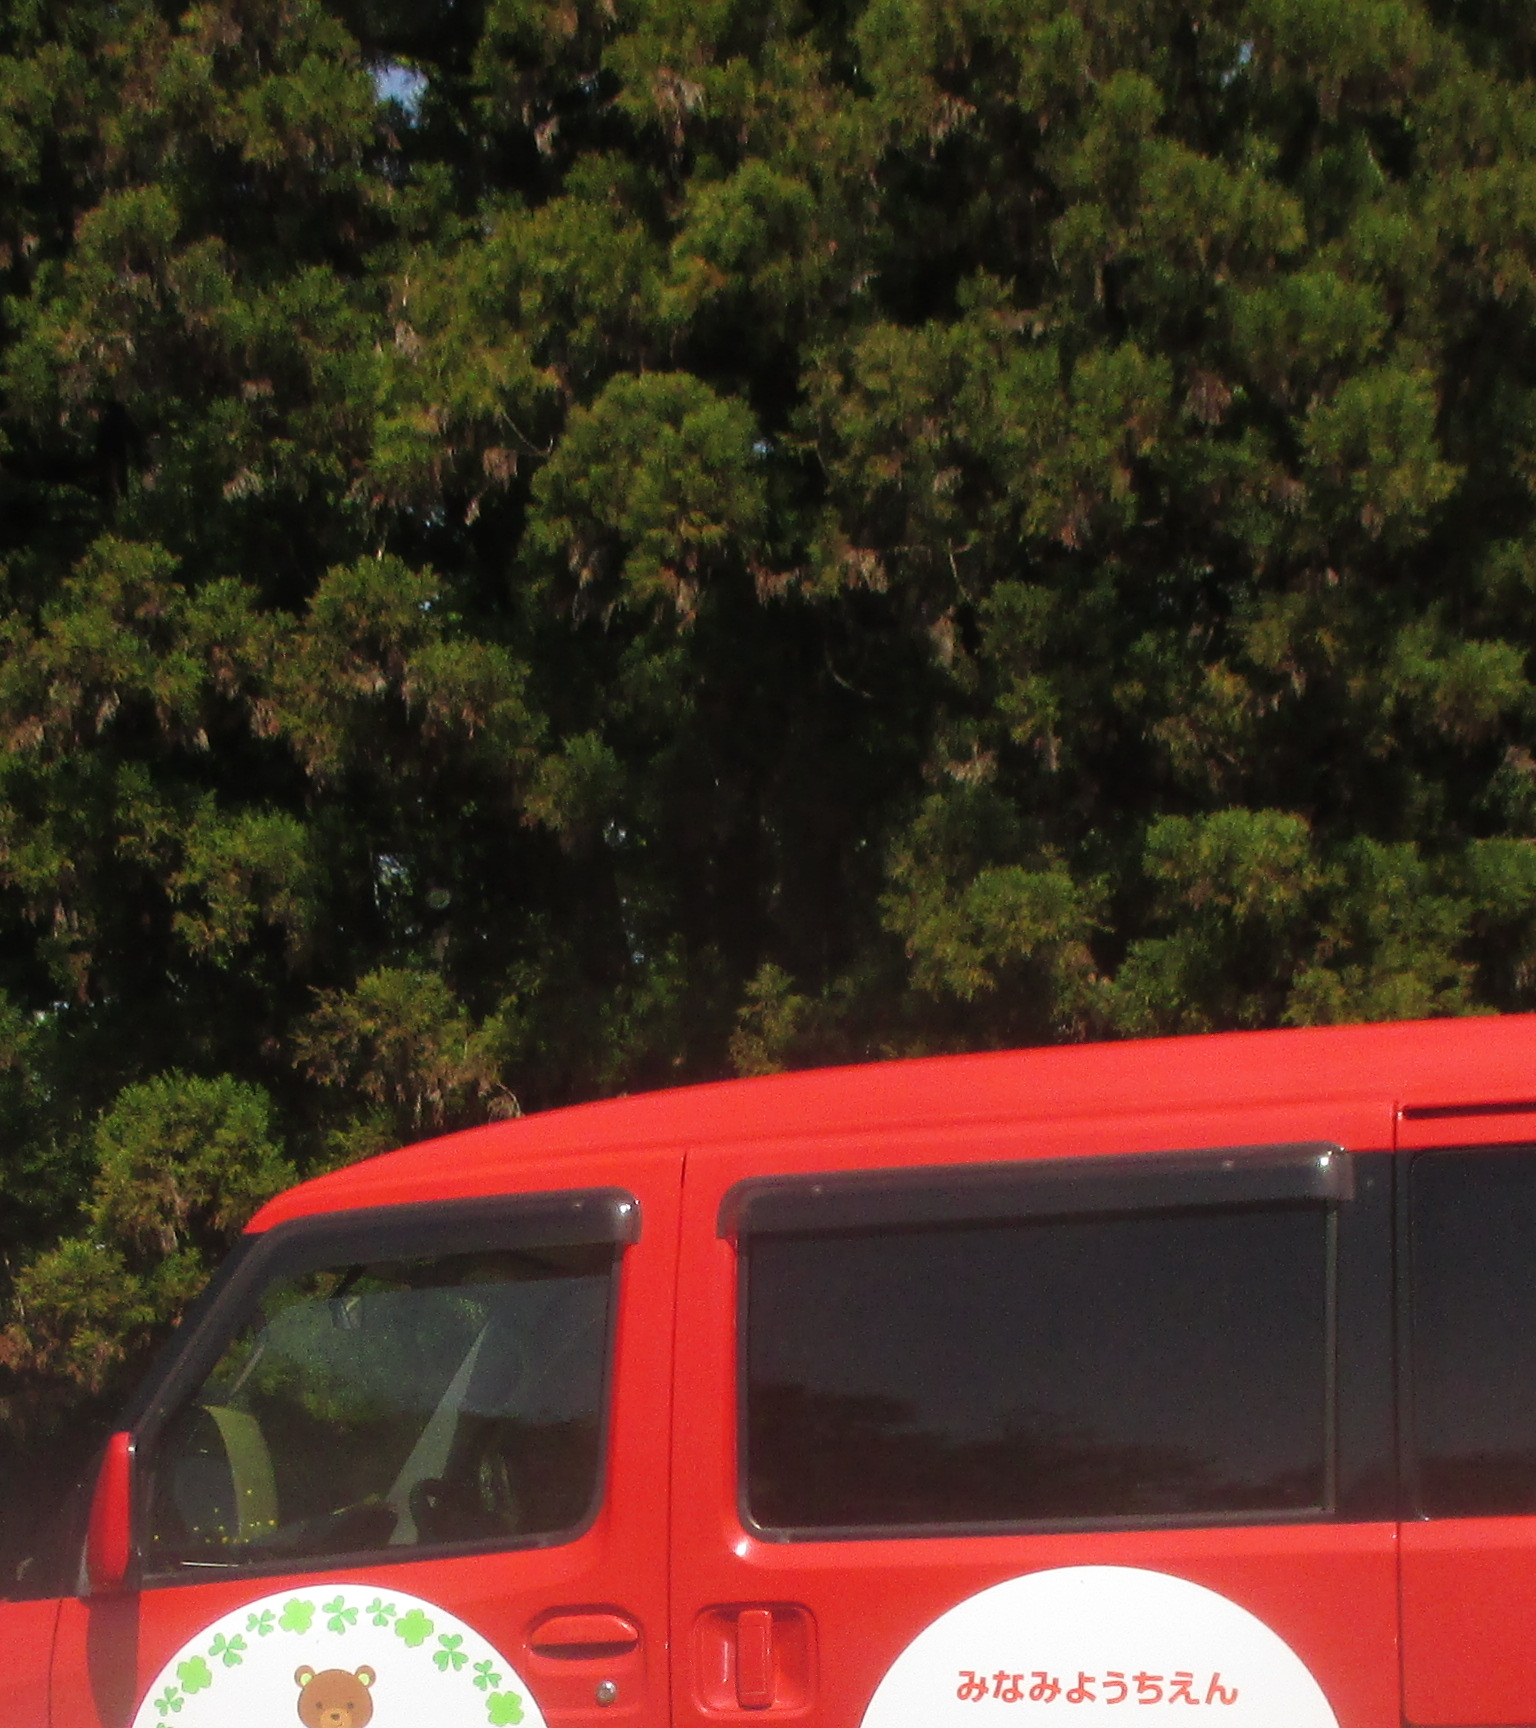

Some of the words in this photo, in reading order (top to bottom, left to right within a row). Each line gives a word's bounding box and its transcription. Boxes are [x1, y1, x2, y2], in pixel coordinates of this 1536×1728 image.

[956, 1669, 1239, 1706] みなみようちえん
